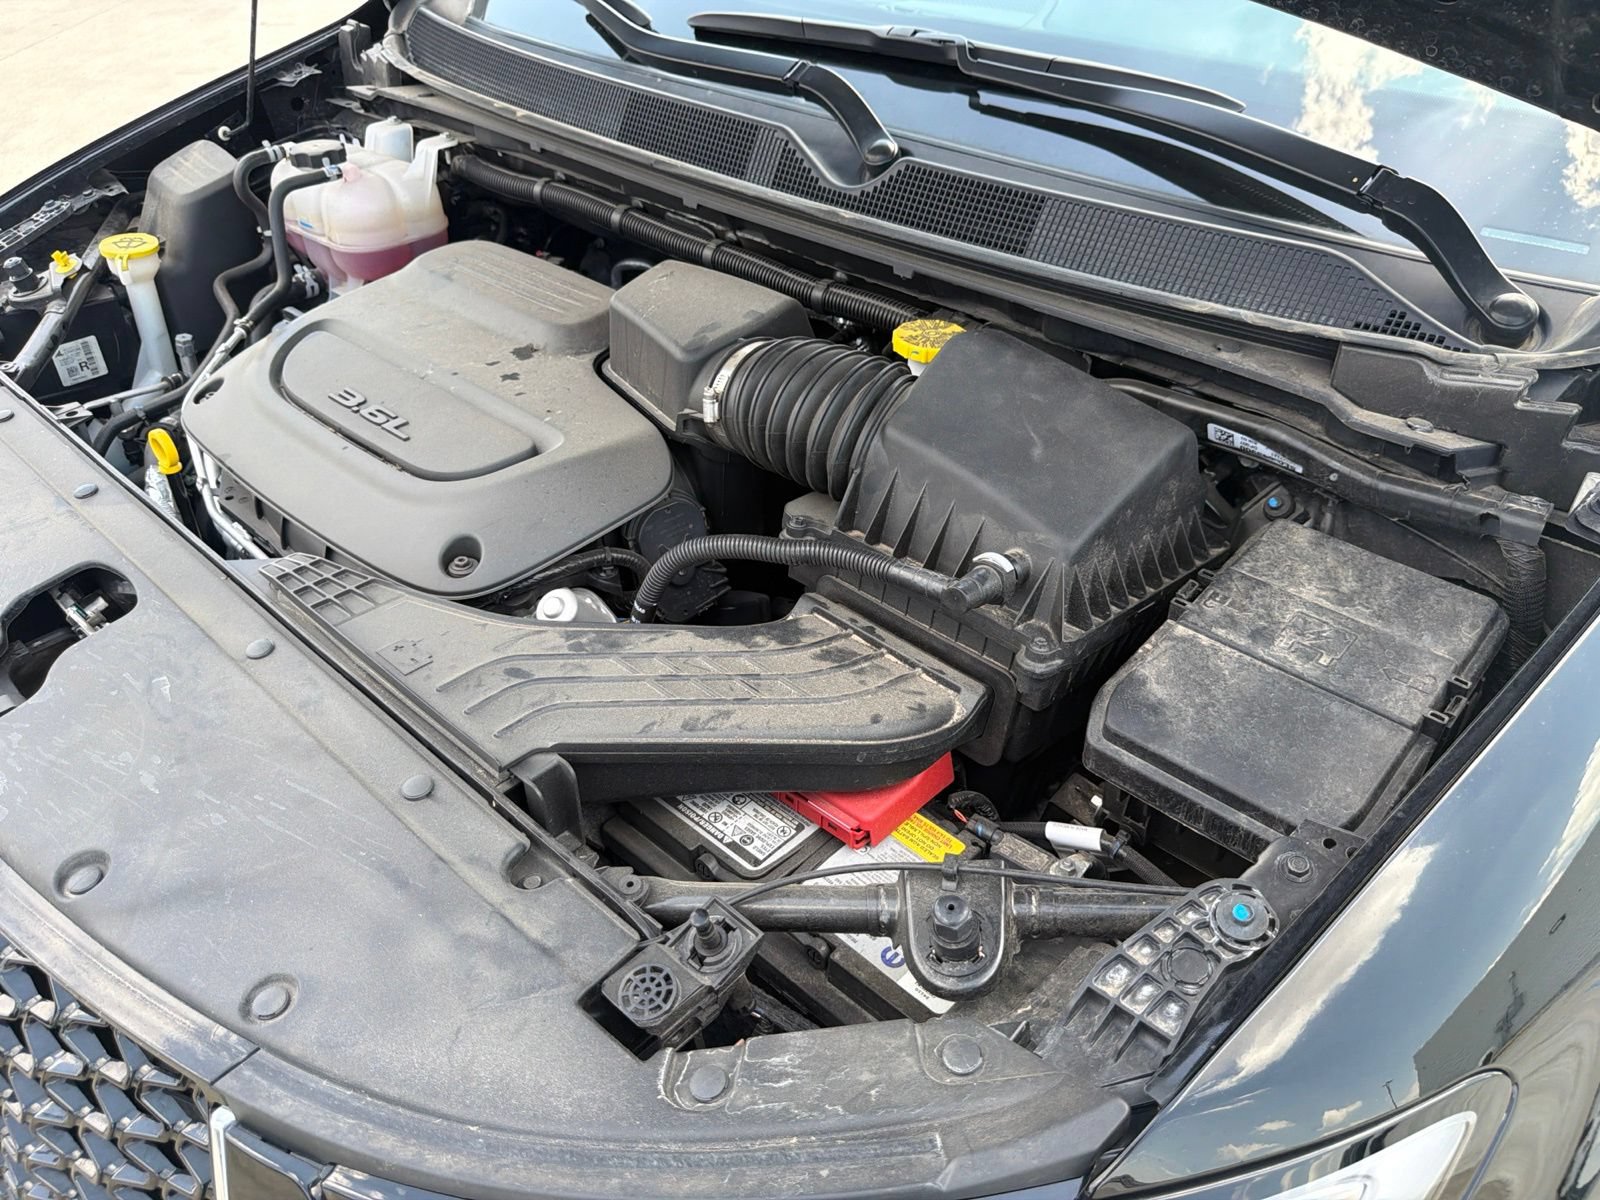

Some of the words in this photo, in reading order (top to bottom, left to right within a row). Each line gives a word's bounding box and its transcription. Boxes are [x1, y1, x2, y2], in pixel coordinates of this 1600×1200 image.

[79, 361, 91, 372] R
[327, 387, 411, 441] 3.6L
[676, 803, 725, 839] DANGER/POISON
